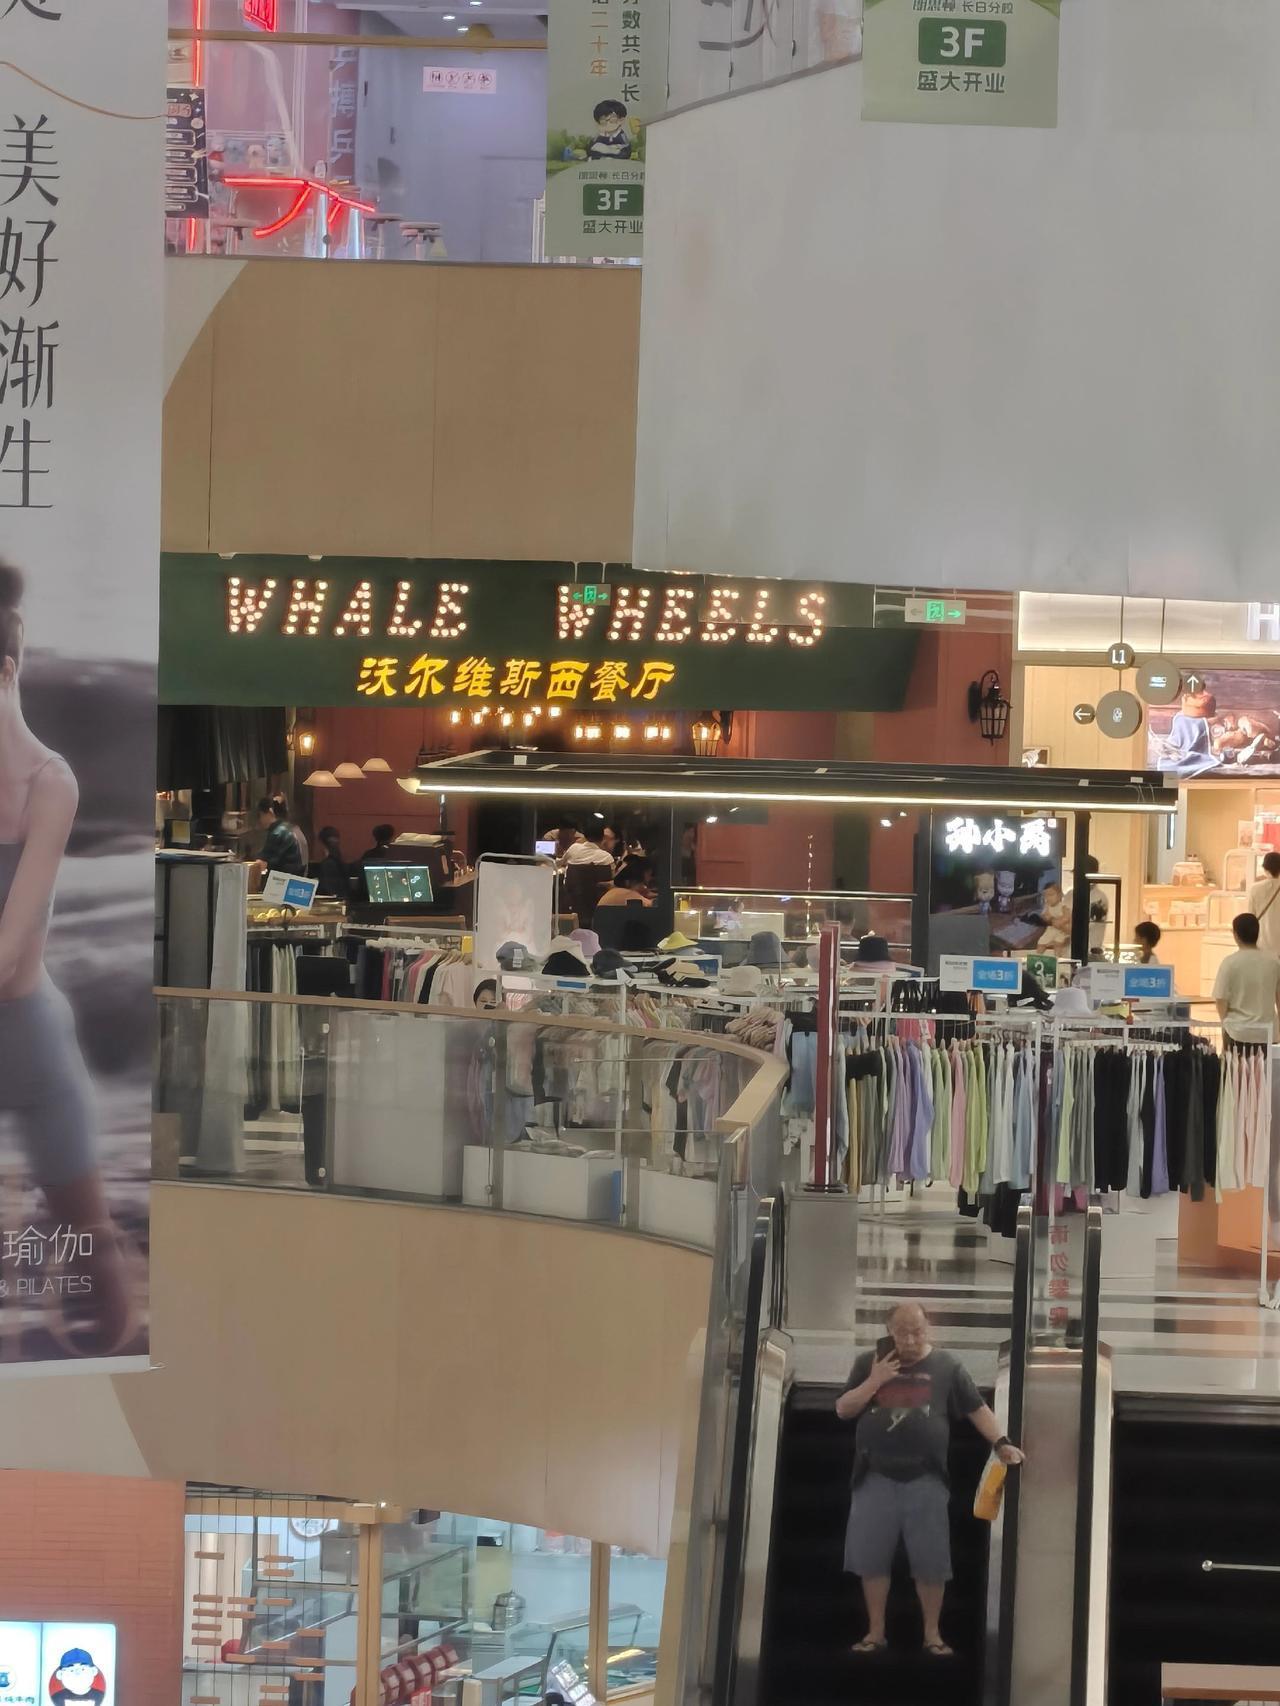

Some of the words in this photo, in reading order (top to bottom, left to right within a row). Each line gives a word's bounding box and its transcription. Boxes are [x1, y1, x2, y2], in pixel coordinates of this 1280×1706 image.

[621, 0, 641, 102] 数共成长
[940, 26, 985, 58] 3F
[917, 71, 1005, 93] 盛大开业
[597, 189, 629, 211] 3F
[583, 220, 643, 234] 盛大开业
[0, 114, 60, 509] 美好渐生
[226, 575, 471, 637] WHALE
[556, 582, 828, 647] WHEELS
[1111, 649, 1126, 665] L1
[356, 653, 675, 701] 沃尔维斯西餐厅
[1, 1223, 93, 1267] 瑜伽
[16, 1275, 92, 1296] PILATES
